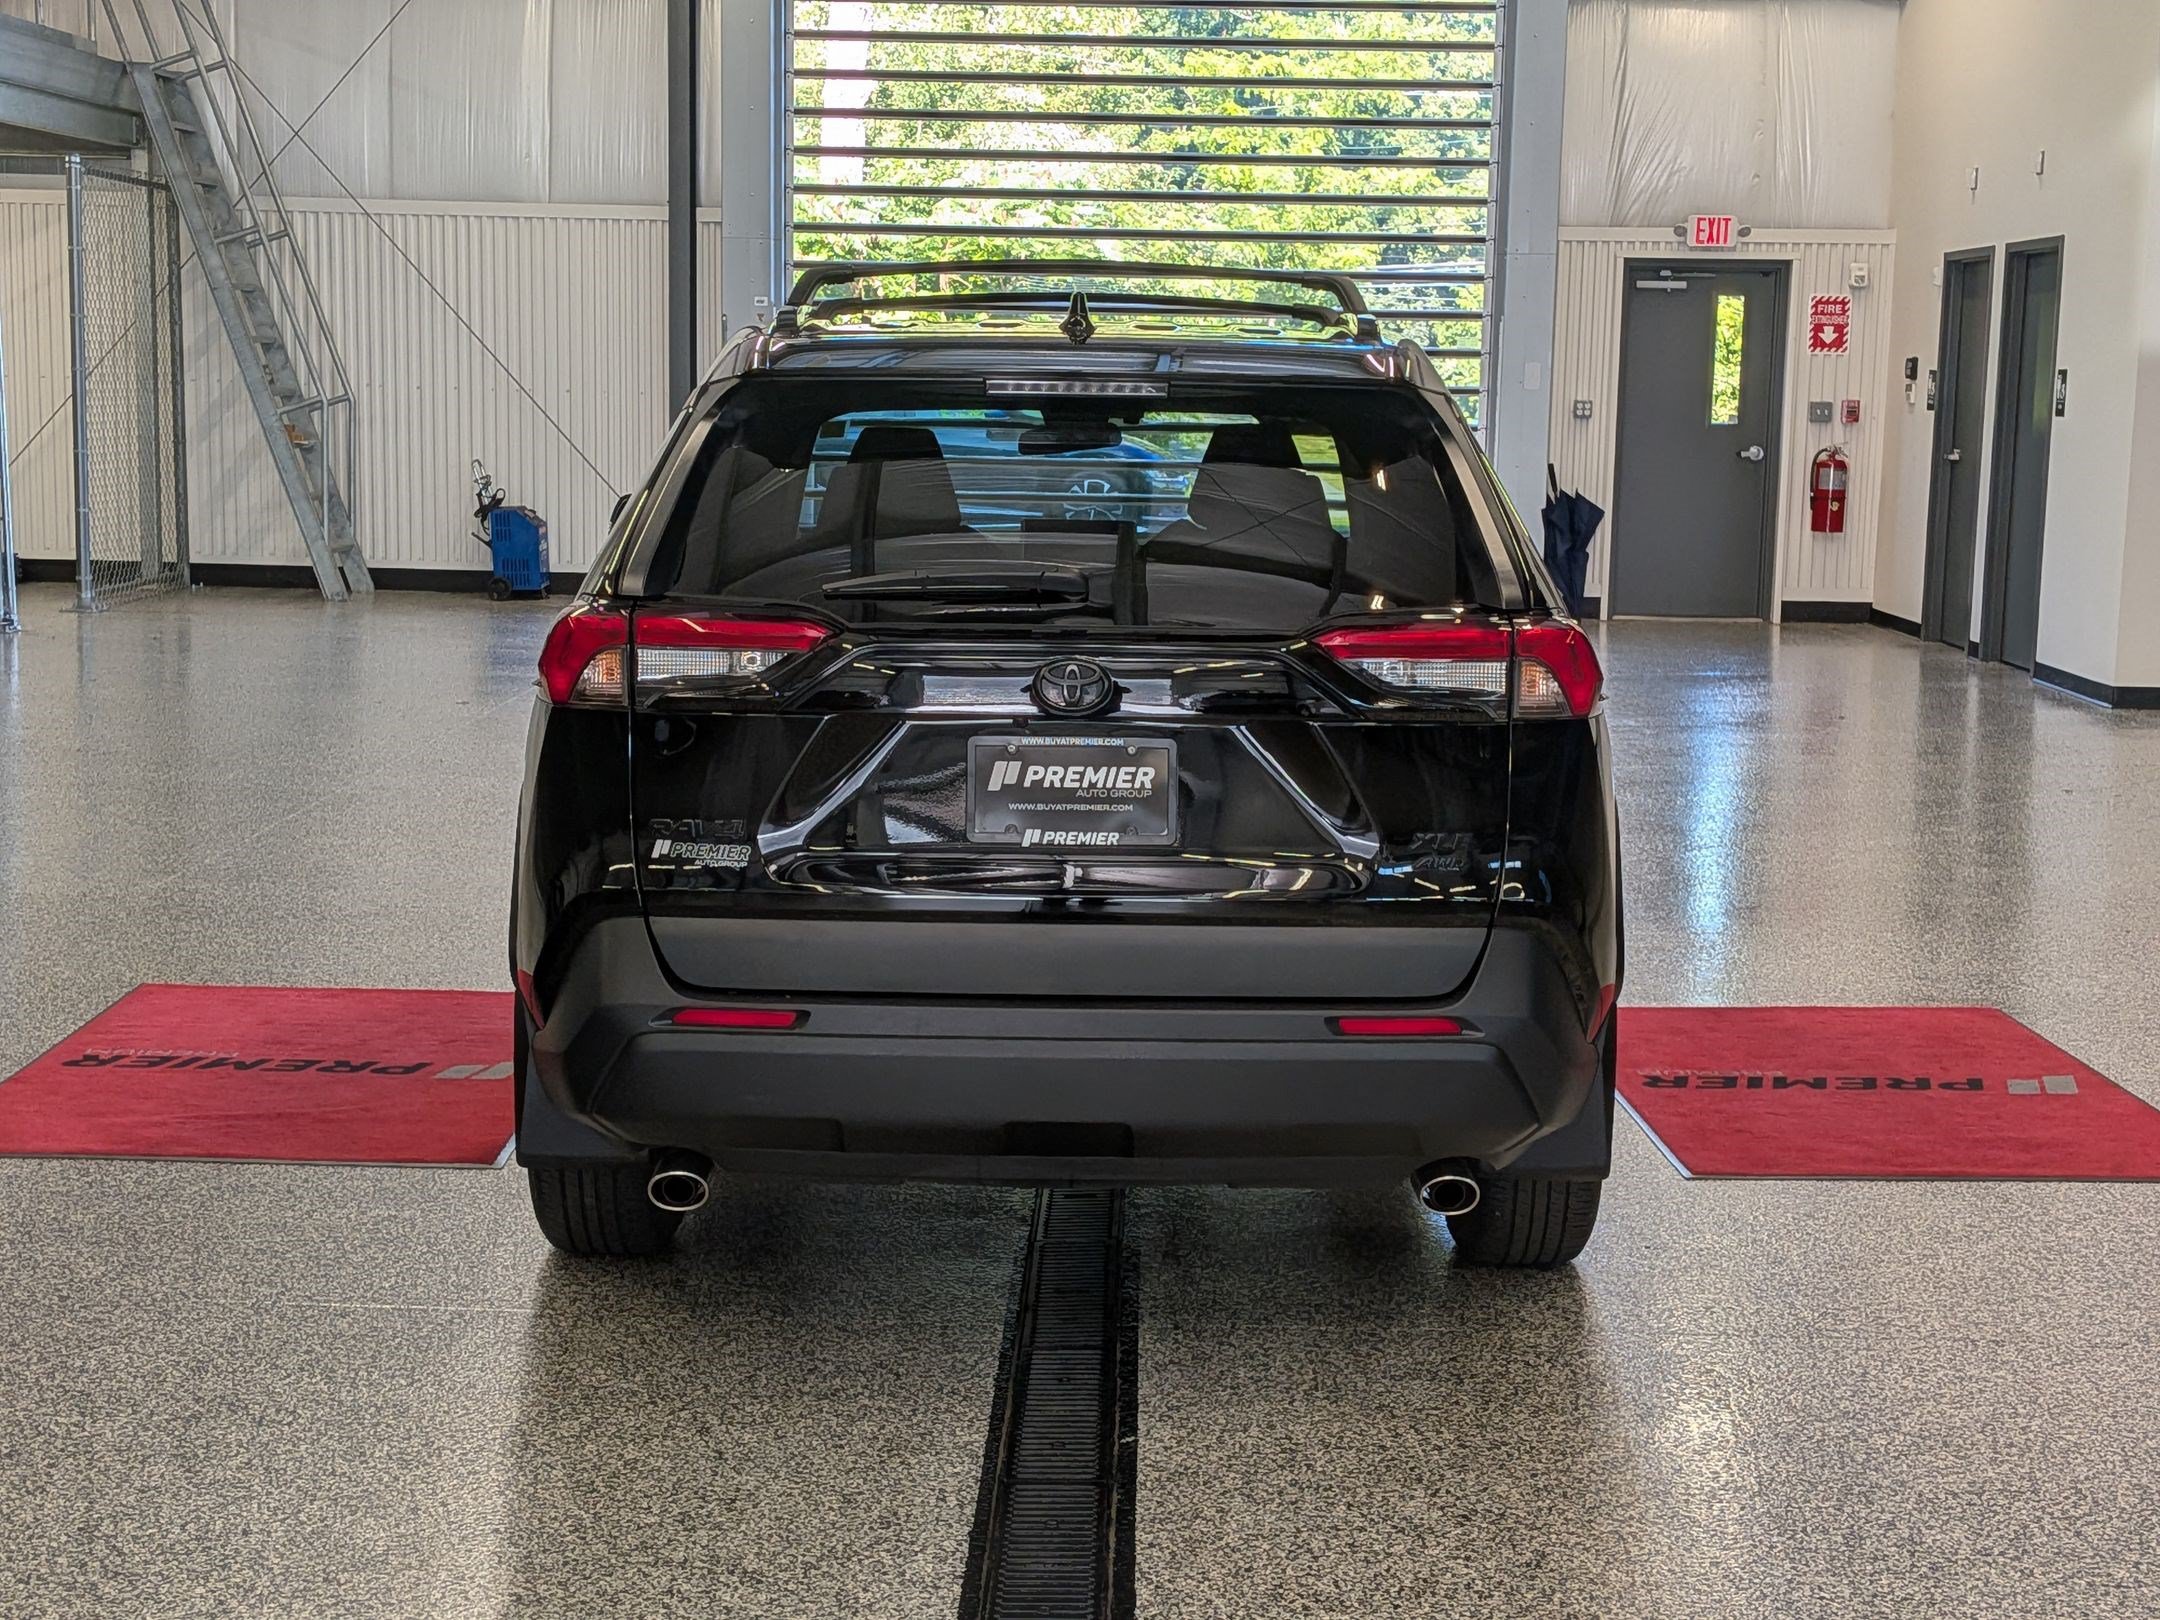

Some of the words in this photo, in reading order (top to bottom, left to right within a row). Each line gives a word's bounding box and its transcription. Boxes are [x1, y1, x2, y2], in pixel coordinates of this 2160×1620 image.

[1695, 217, 1732, 244] EXIT
[1817, 304, 1843, 314] FIRE
[1021, 737, 1124, 746] WWW.BUYATPREMIER.COM
[1023, 765, 1156, 789] PREMIER
[1075, 789, 1107, 798] AUTO
[1110, 789, 1152, 799] GROUP
[1008, 803, 1134, 812] WWW.BUYATPREMIER.COM
[1042, 830, 1120, 846] PREMIER
[670, 842, 752, 860] PREMIER
[694, 859, 717, 868] AUTO
[717, 860, 748, 868] GROUP
[63, 1054, 433, 1075] PREMIER
[1642, 1075, 1983, 1091] PREMIER
